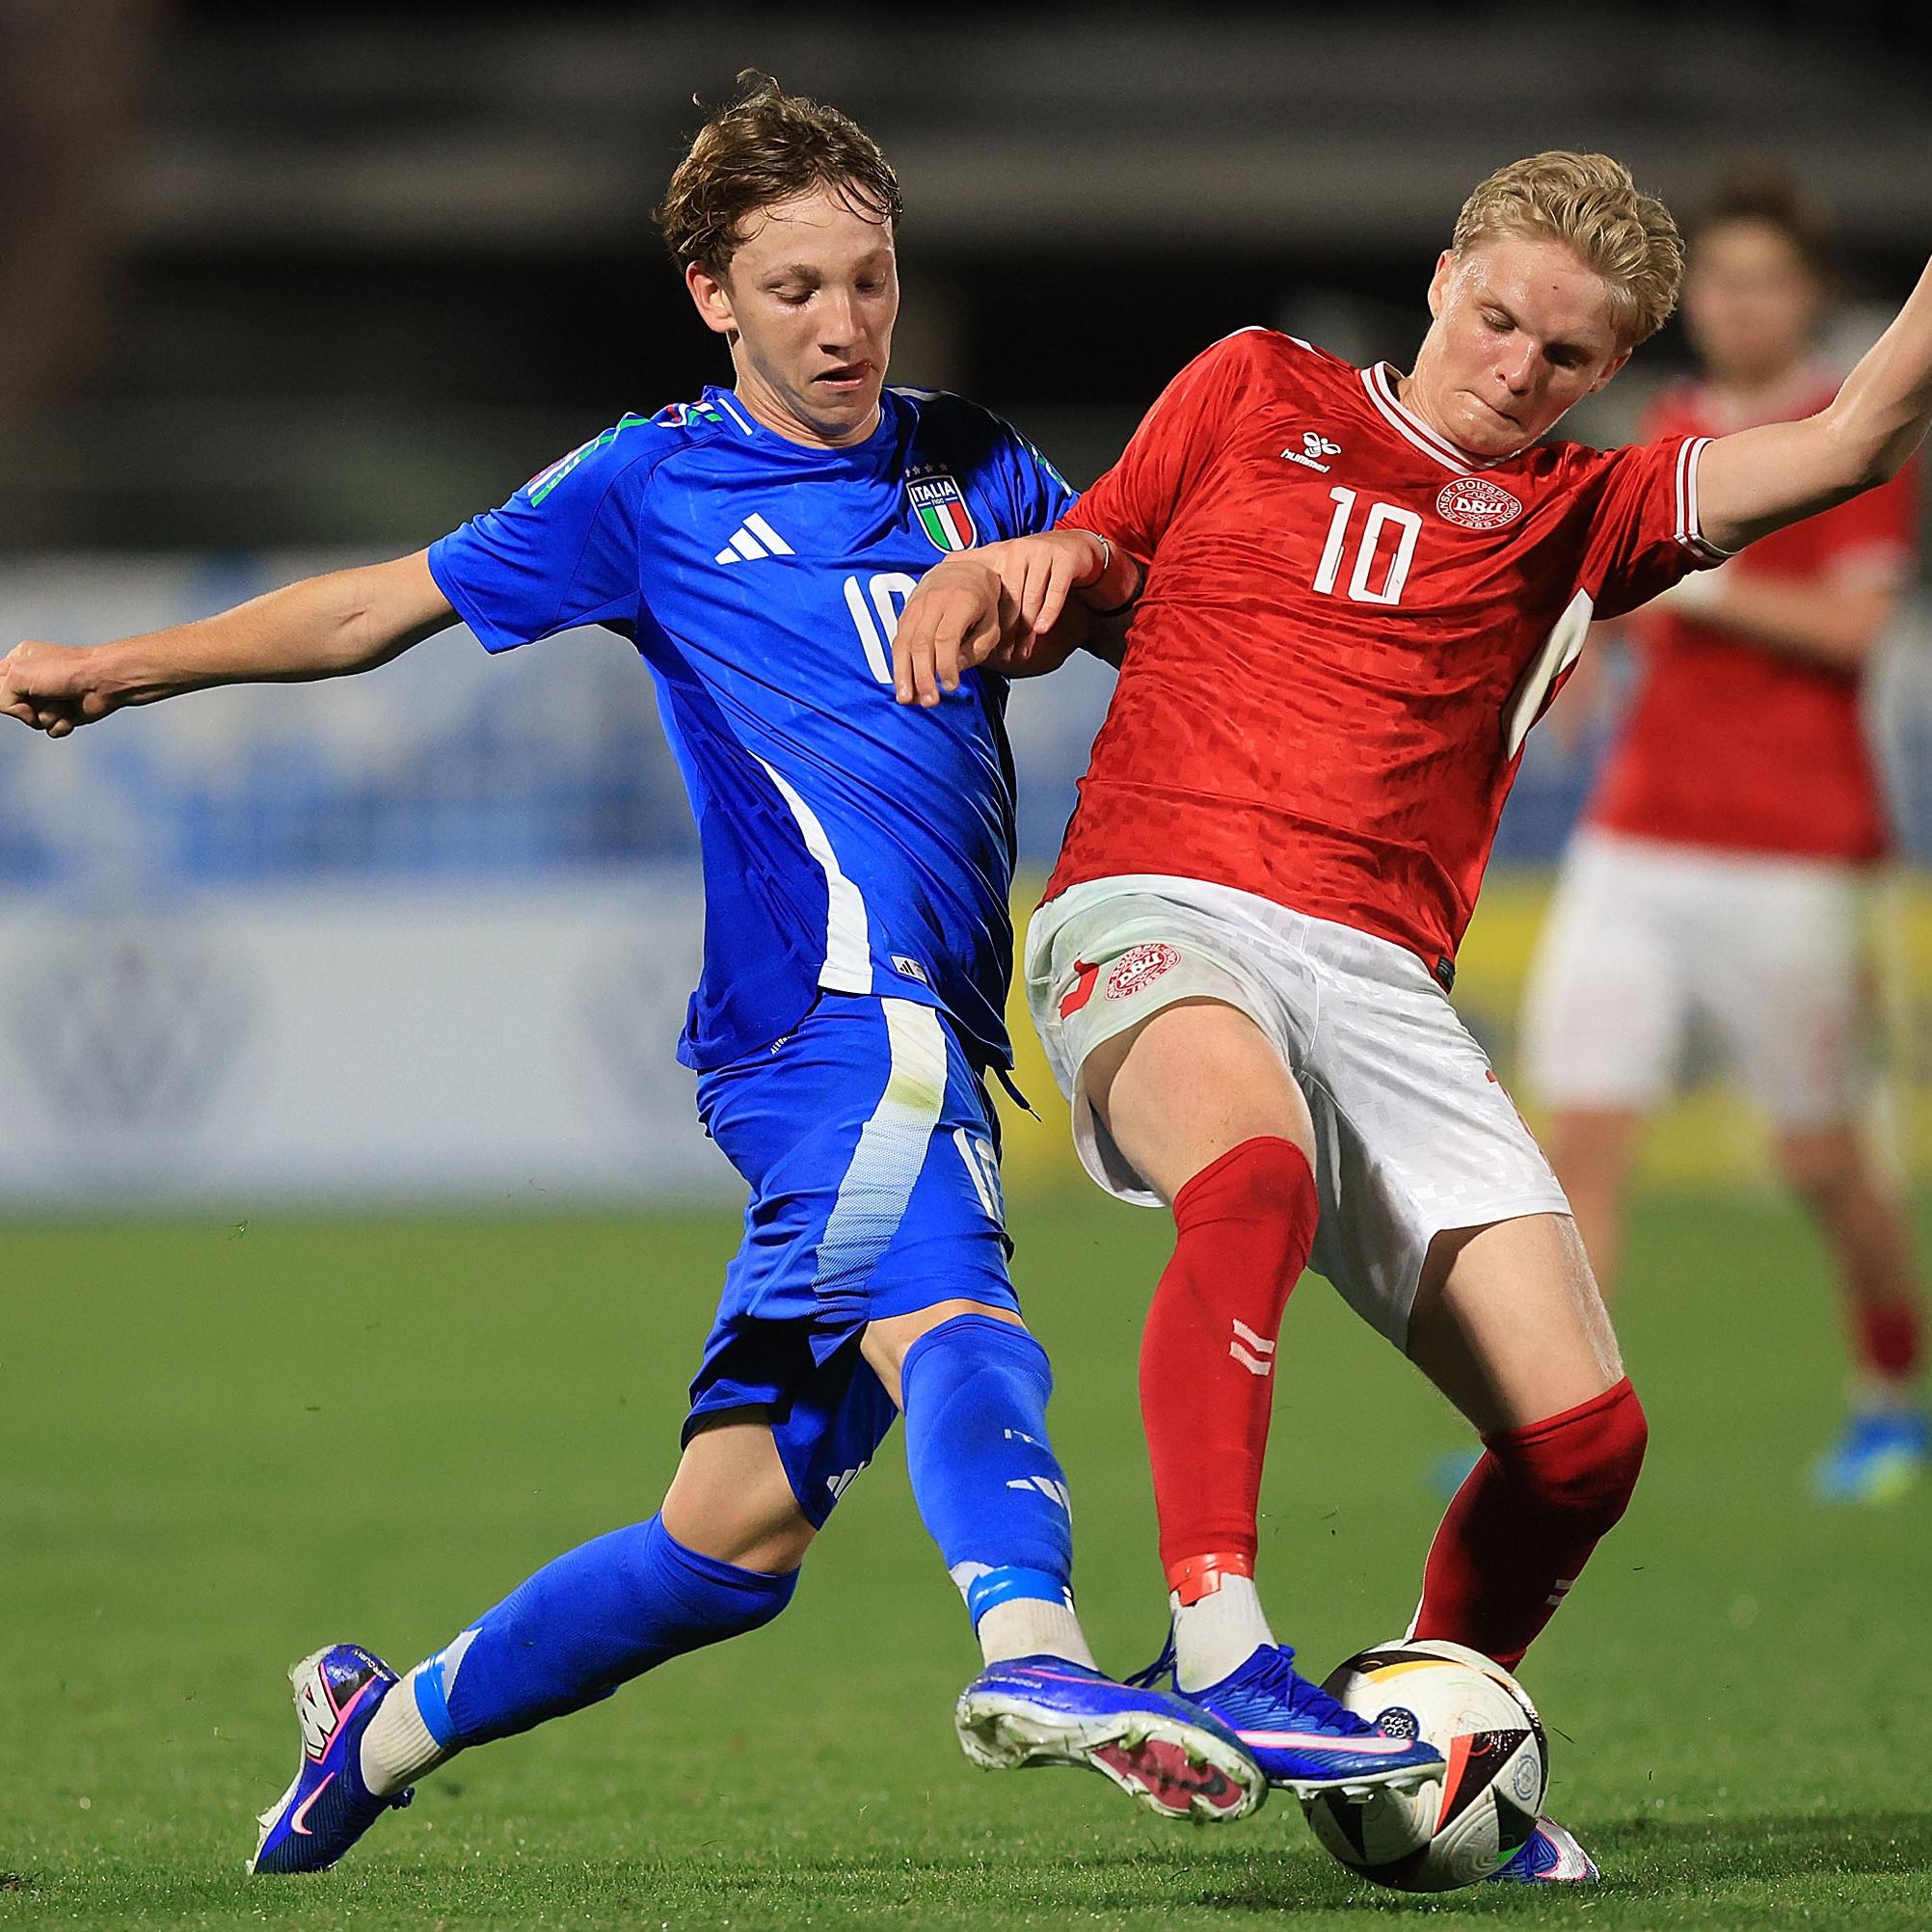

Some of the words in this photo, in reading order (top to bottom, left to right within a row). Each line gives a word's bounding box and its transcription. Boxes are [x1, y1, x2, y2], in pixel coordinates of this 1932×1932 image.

[1280, 447, 1331, 473] hummel
[910, 481, 956, 502] ITALIA
[1453, 496, 1504, 514] DBU
[1312, 486, 1423, 605] 10
[1118, 952, 1164, 988] DBU
